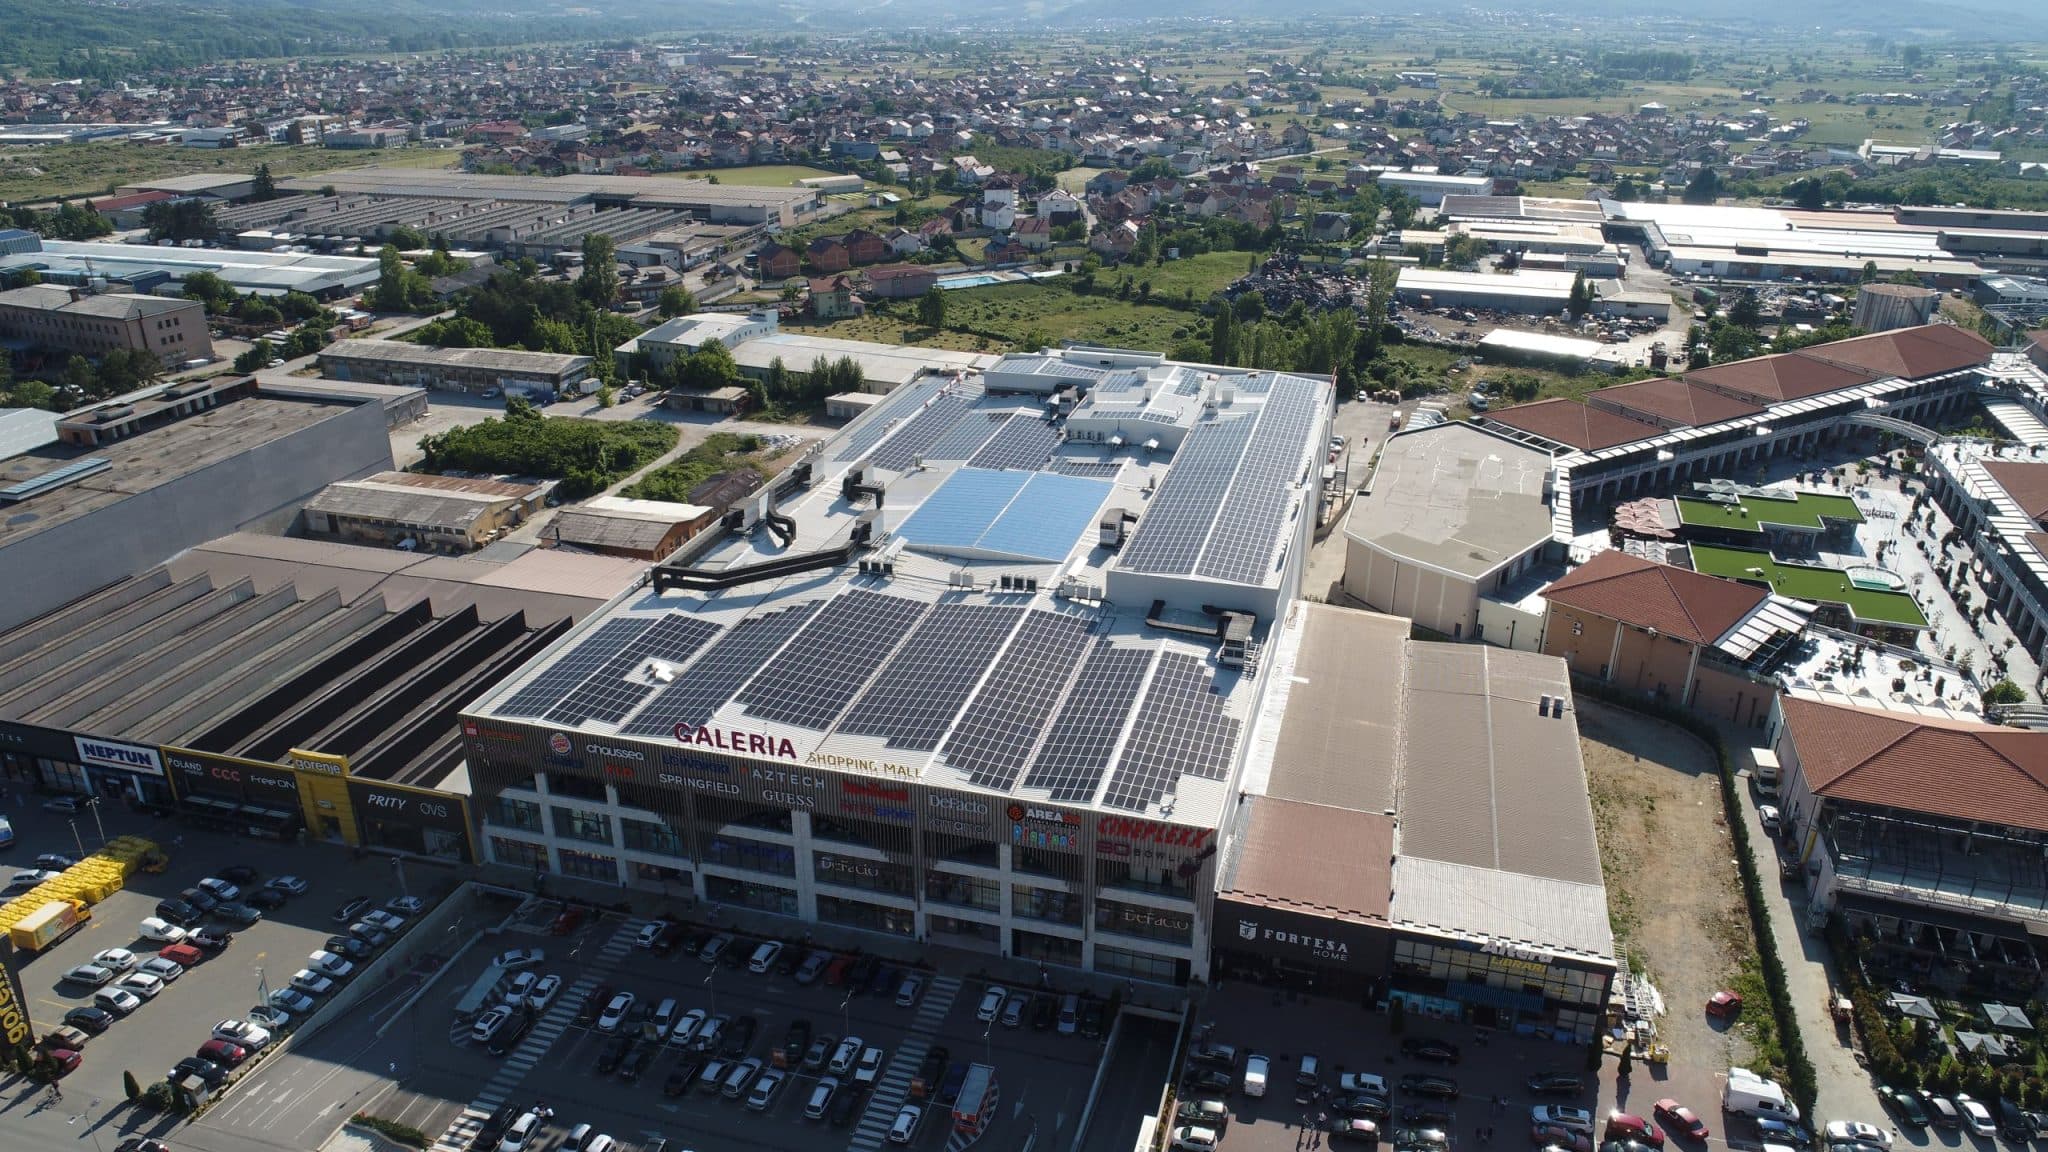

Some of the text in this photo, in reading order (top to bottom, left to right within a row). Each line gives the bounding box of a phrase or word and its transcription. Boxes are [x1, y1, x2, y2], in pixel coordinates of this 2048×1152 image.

[674, 722, 797, 759] GALERIA
[82, 743, 152, 766] NEPTUN
[586, 743, 644, 761] chaussea
[167, 757, 202, 771] POLAND
[295, 759, 341, 776] gorenje
[807, 752, 922, 780] SHOPPING MALL
[211, 767, 240, 782] CCC
[658, 773, 740, 795] SPRINGFIELD
[752, 768, 825, 790] AZTECH
[368, 794, 406, 810] PRITY
[762, 789, 815, 808] GUESS
[930, 794, 988, 816] DeFacto
[419, 802, 448, 818] OVS
[1026, 808, 1064, 823] AREA
[1098, 815, 1214, 848] CINEPLEXX
[1264, 929, 1348, 953] FORTESA
[1312, 949, 1349, 961] HOME
[1481, 940, 1553, 964] Altera
